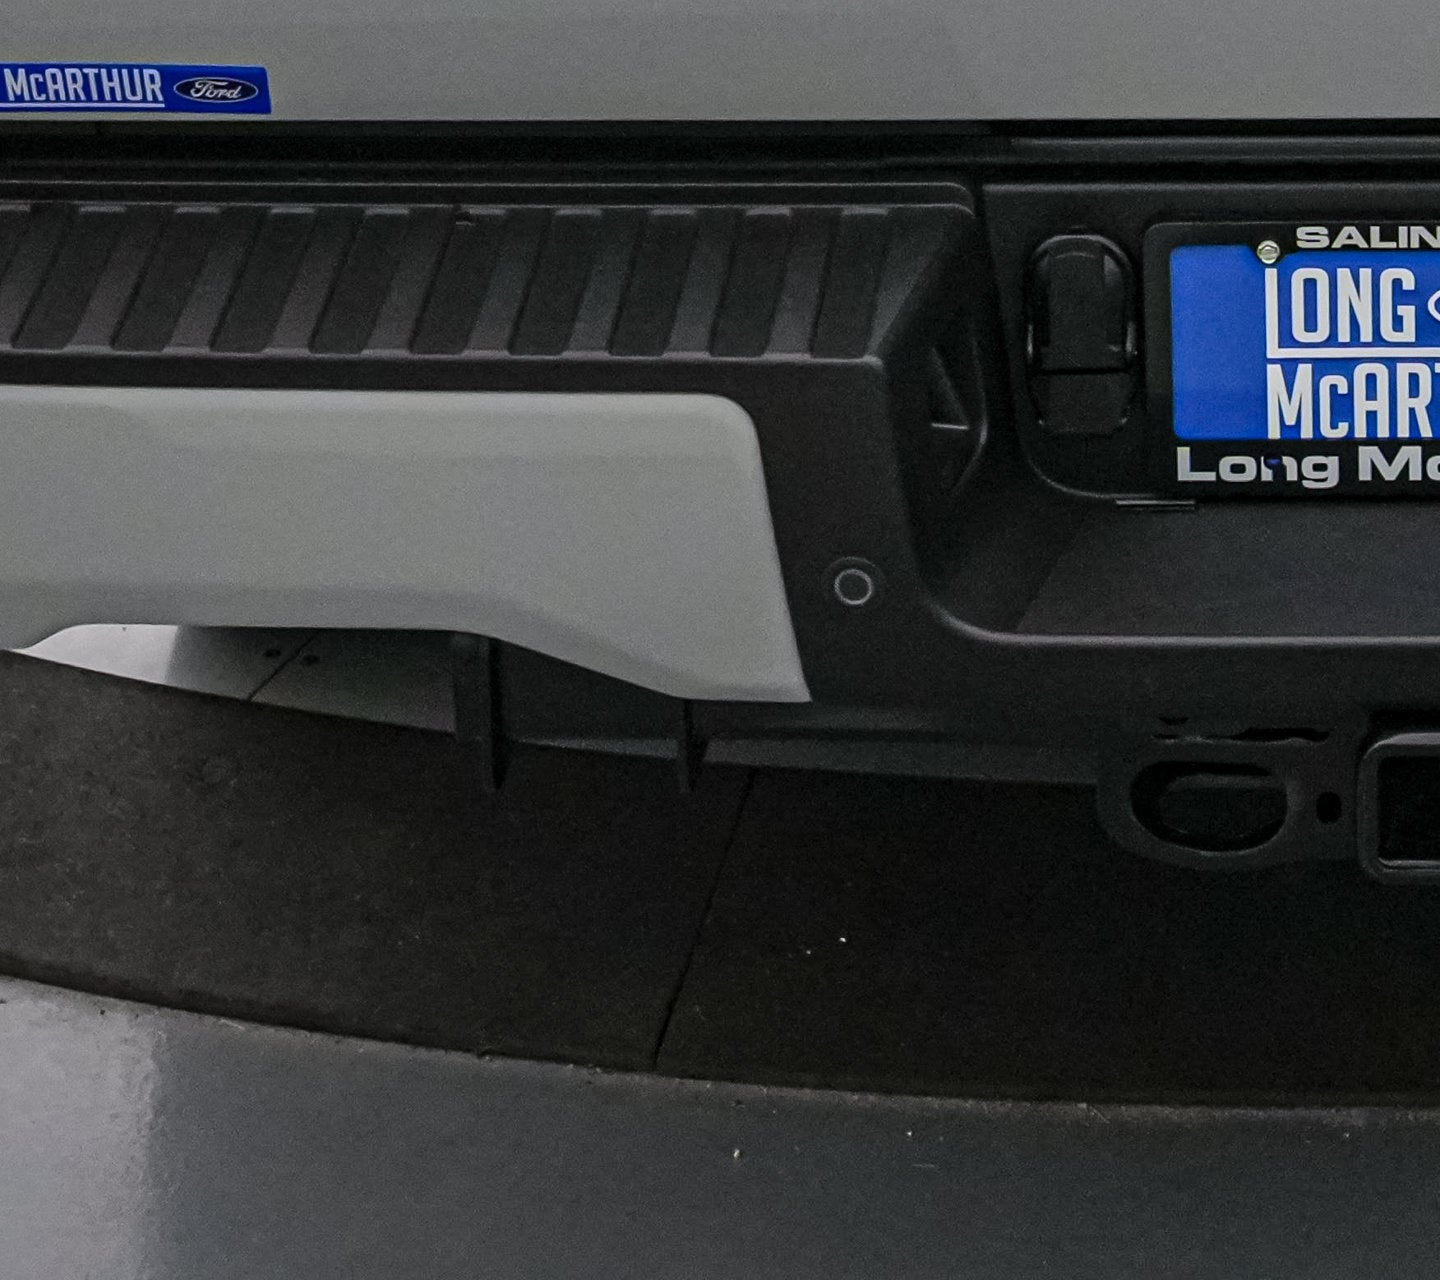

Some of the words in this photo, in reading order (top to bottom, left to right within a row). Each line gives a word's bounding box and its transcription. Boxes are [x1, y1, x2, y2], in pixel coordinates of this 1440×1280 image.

[3, 68, 164, 102] McARTHUR
[190, 79, 243, 100] Ford
[1264, 268, 1417, 357] LONG
[1176, 446, 1339, 488] Long
